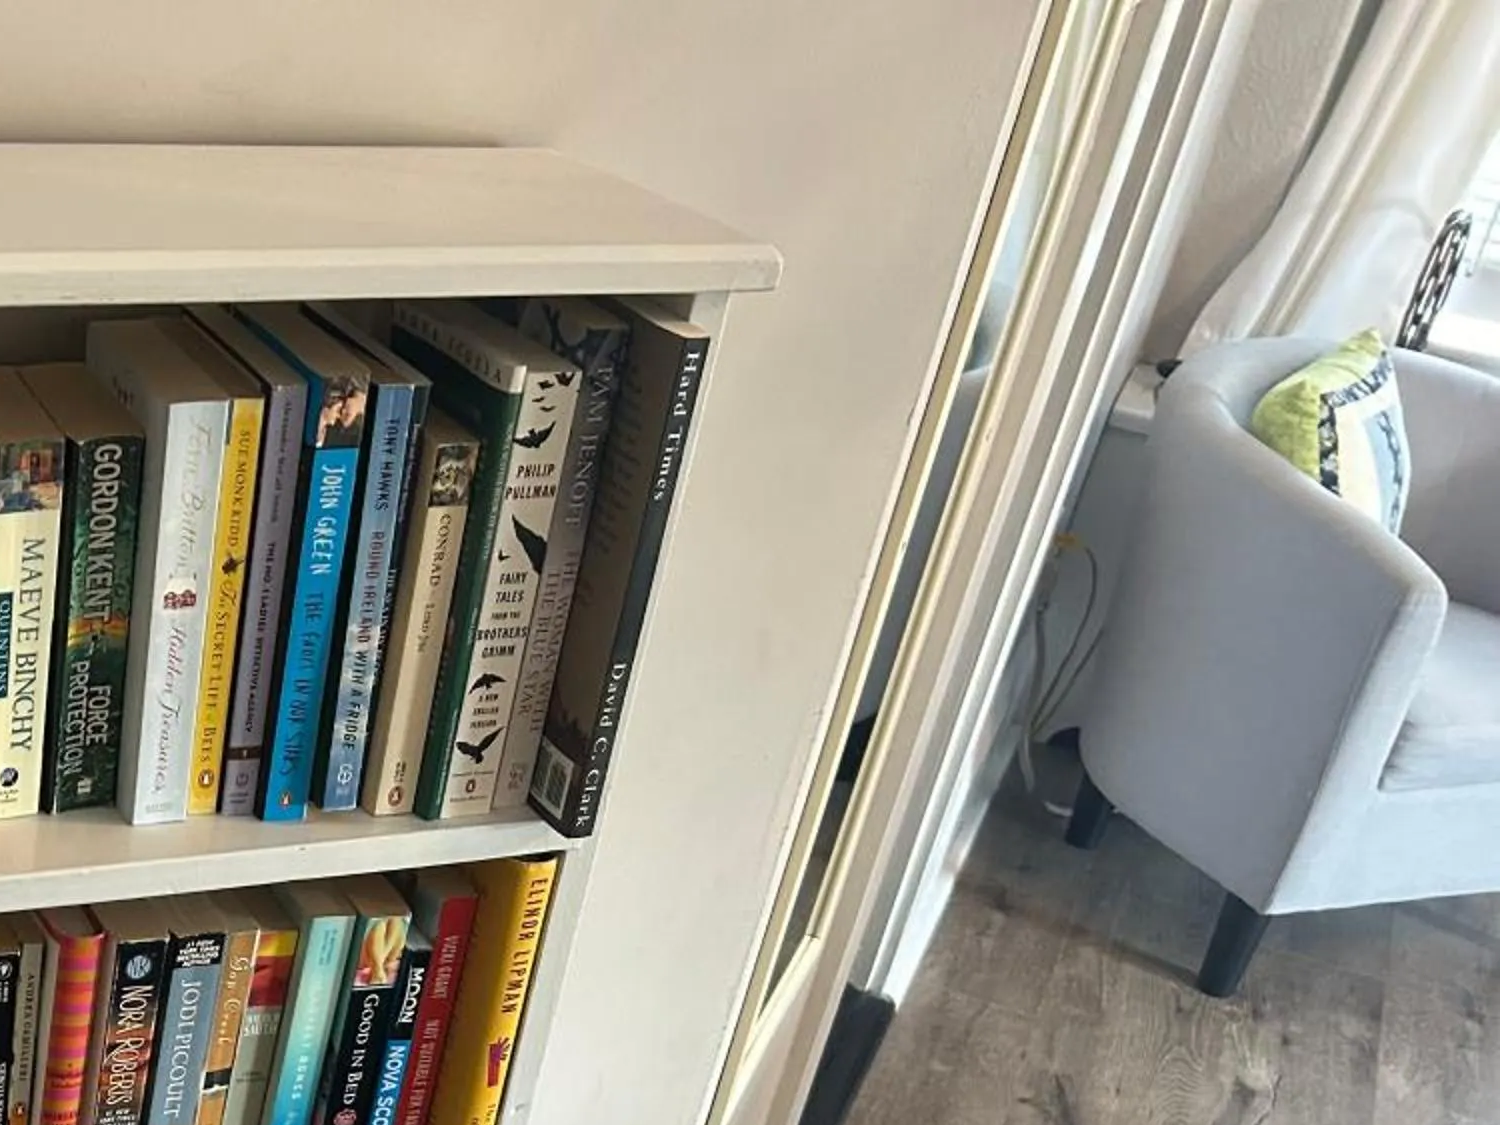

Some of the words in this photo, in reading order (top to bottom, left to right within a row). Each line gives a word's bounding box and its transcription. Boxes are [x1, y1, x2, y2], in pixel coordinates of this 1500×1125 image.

[586, 367, 613, 422] PAM
[672, 352, 700, 418] Hard
[238, 429, 251, 455] SUE
[382, 418, 401, 455] TONY
[231, 462, 247, 507] MONK
[318, 464, 347, 509] JOHN
[373, 462, 396, 511] HAWKS
[515, 464, 555, 478] PHILIP
[654, 426, 683, 501] Times
[87, 444, 122, 549] GORDON
[505, 485, 556, 499] PULLMAN
[226, 509, 242, 548] KIDD
[309, 517, 338, 575] GREEN
[429, 514, 452, 587] CONRAD
[365, 531, 385, 579] ROUND
[499, 571, 528, 585] FAIRY
[16, 538, 46, 644] MAEVE
[83, 554, 114, 621] KENT
[303, 592, 325, 622] THE
[495, 590, 525, 603] TALES
[356, 585, 377, 643] IRELAND
[475, 626, 529, 641] BROTHERS
[163, 624, 189, 696] Hidden
[211, 611, 230, 671] SECRET
[350, 650, 369, 684] WITH
[10, 653, 39, 751] BINCHY
[61, 660, 91, 777] PROTECTION
[86, 685, 112, 746] FORCE
[350, 689, 363, 697] A
[599, 663, 628, 728] David
[153, 696, 184, 791] Treasures
[201, 727, 217, 762] BEES
[342, 701, 362, 751] FRIDGE
[591, 737, 609, 761] C.
[575, 769, 600, 828] Clark
[518, 879, 549, 941] ELINOR
[178, 980, 203, 1028] JODI
[397, 967, 425, 1024] MOON
[501, 949, 532, 1013] LIPMAN
[117, 984, 153, 1033] NORA
[355, 993, 380, 1045] GOOD
[102, 1039, 146, 1106] ROBERTS
[163, 1033, 191, 1119] PICOULT
[351, 1049, 366, 1067] IN
[380, 1045, 407, 1092] NOVA
[343, 1072, 363, 1105] BED
